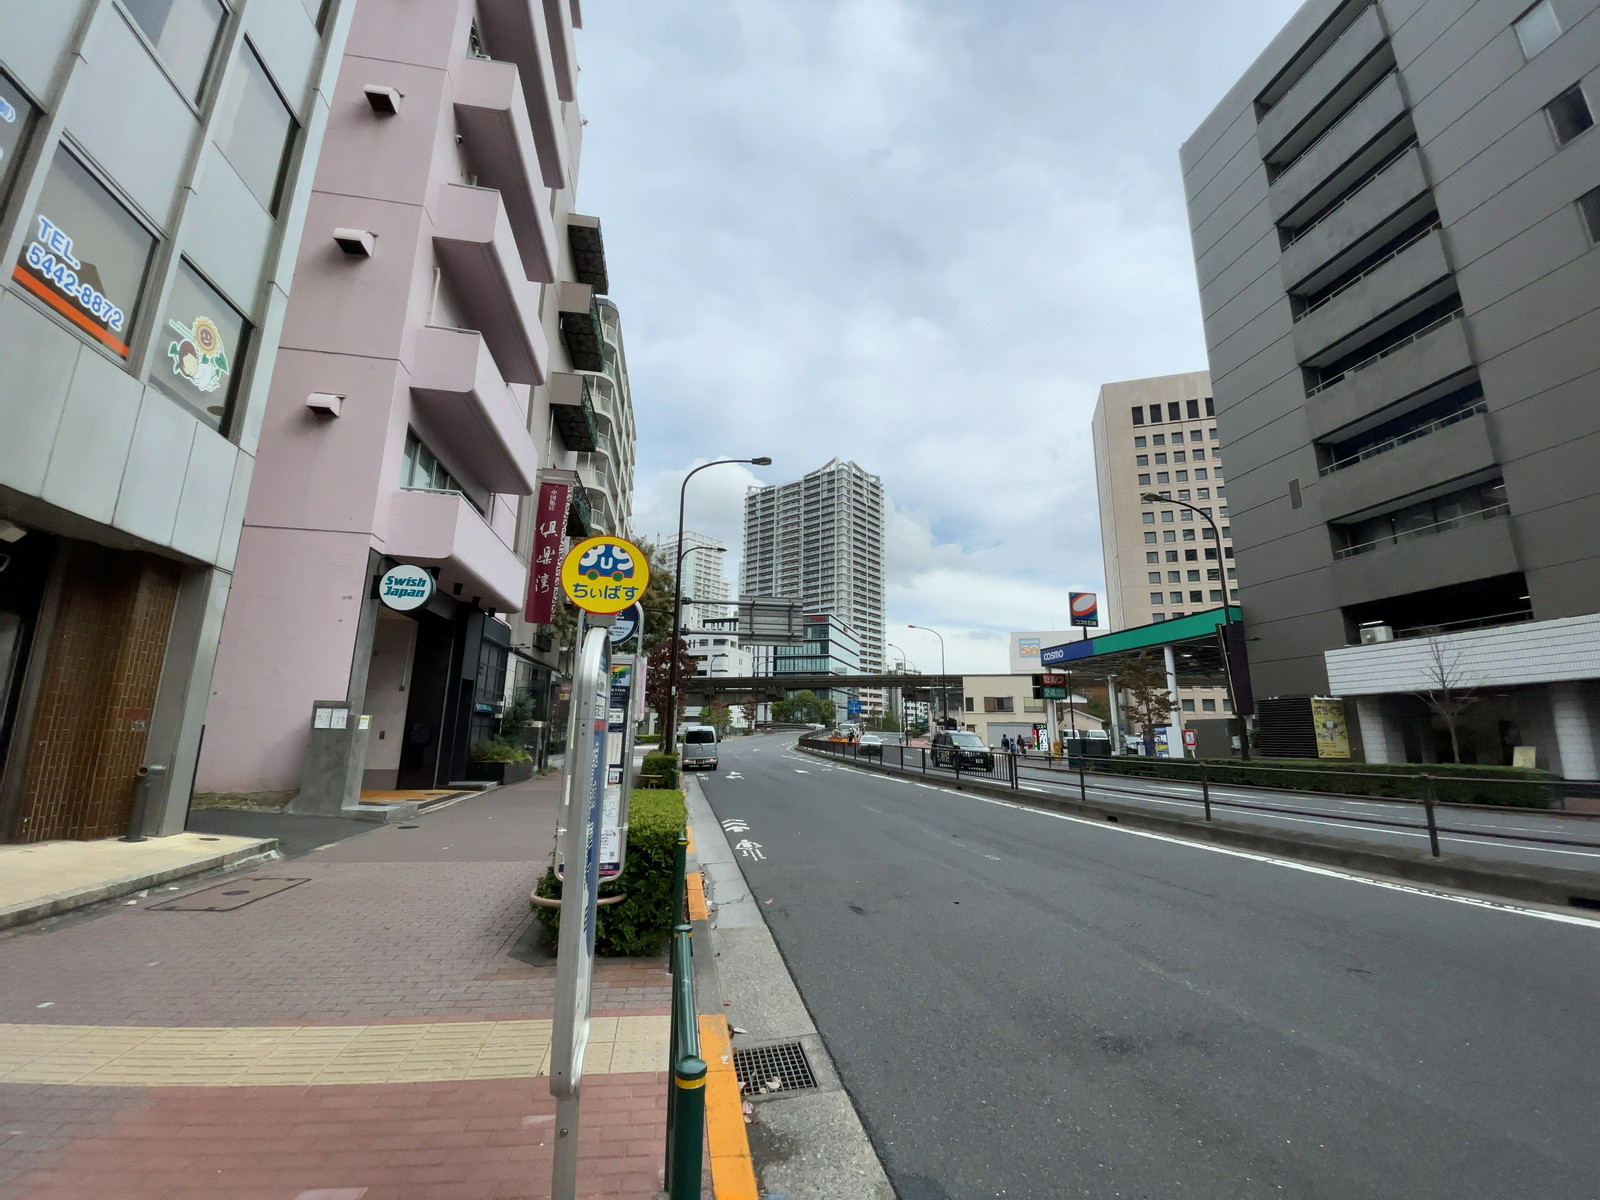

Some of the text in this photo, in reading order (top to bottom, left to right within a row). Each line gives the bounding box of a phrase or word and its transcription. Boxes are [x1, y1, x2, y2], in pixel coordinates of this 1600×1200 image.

[39, 216, 80, 269] TEL.
[27, 243, 123, 331] 5442-8872
[384, 575, 427, 588] Swish
[383, 585, 426, 599] Japan
[1043, 649, 1064, 661] COSMO
